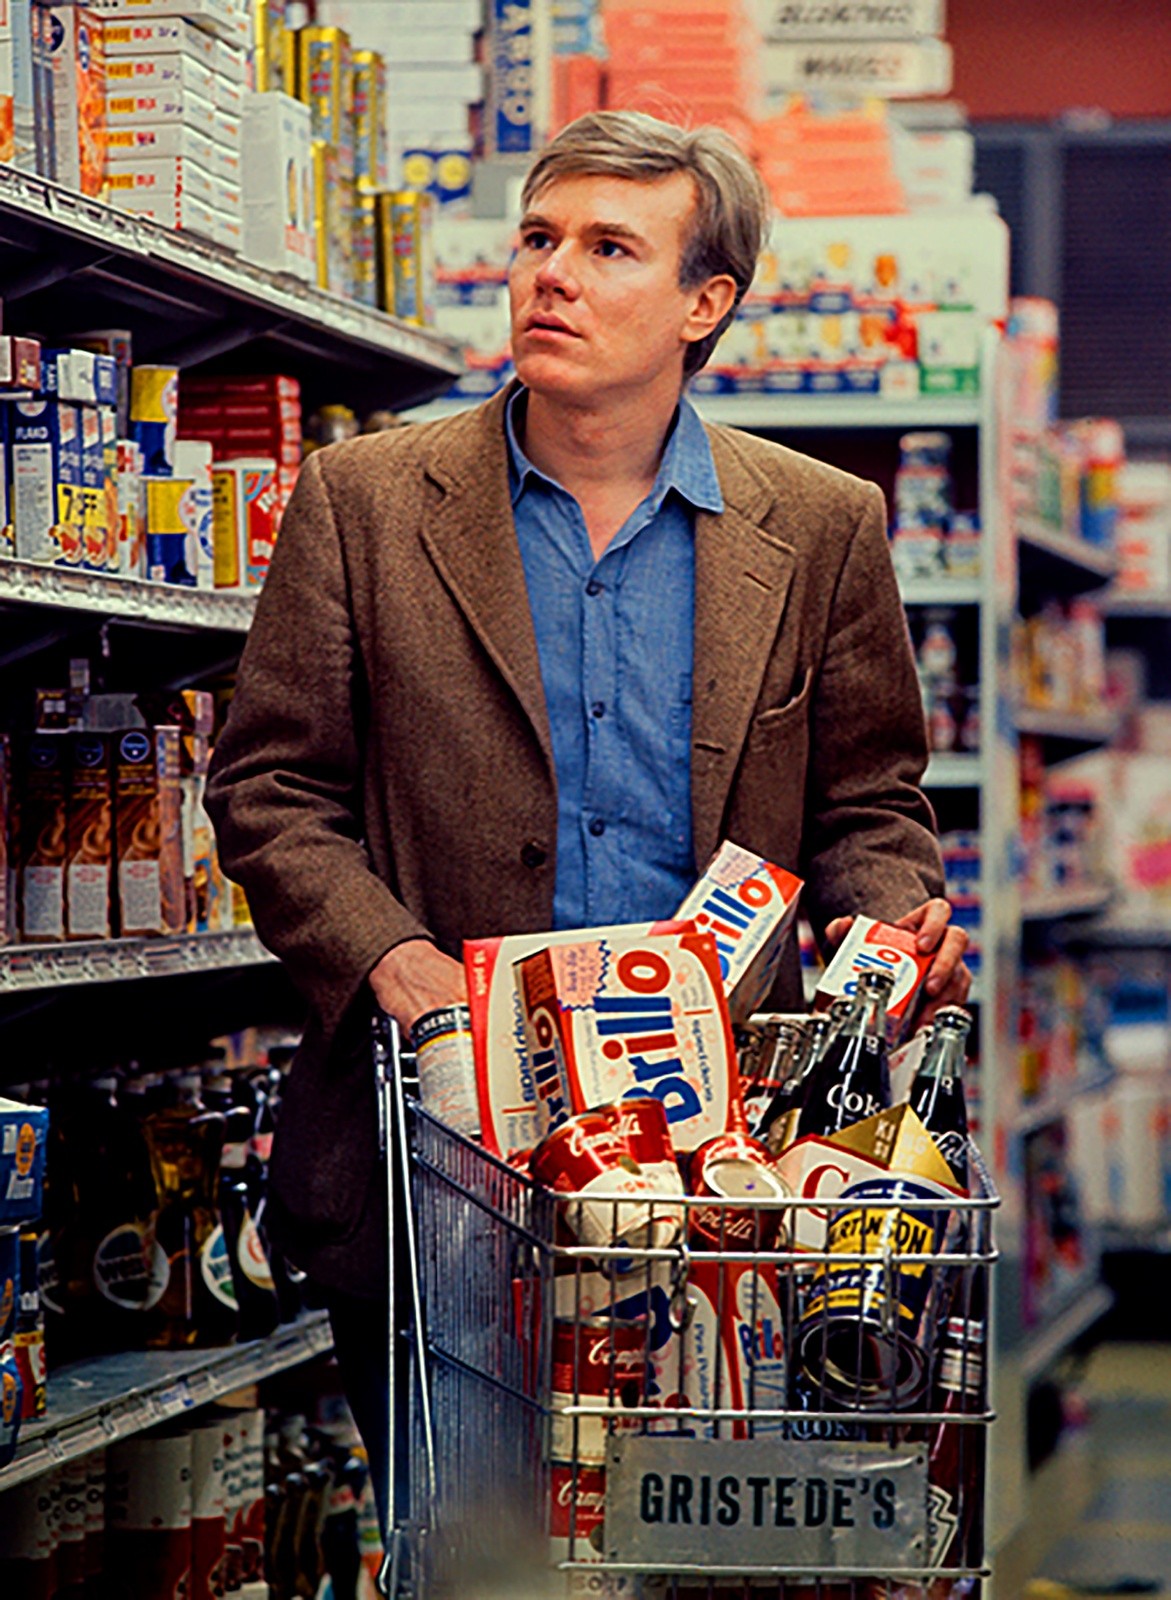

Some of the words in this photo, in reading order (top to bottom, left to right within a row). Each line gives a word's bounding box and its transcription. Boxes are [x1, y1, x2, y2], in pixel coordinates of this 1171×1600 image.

[694, 878, 773, 983] rillo
[826, 1083, 886, 1117] Cok
[639, 1471, 898, 1531] GRISTEDE'S
